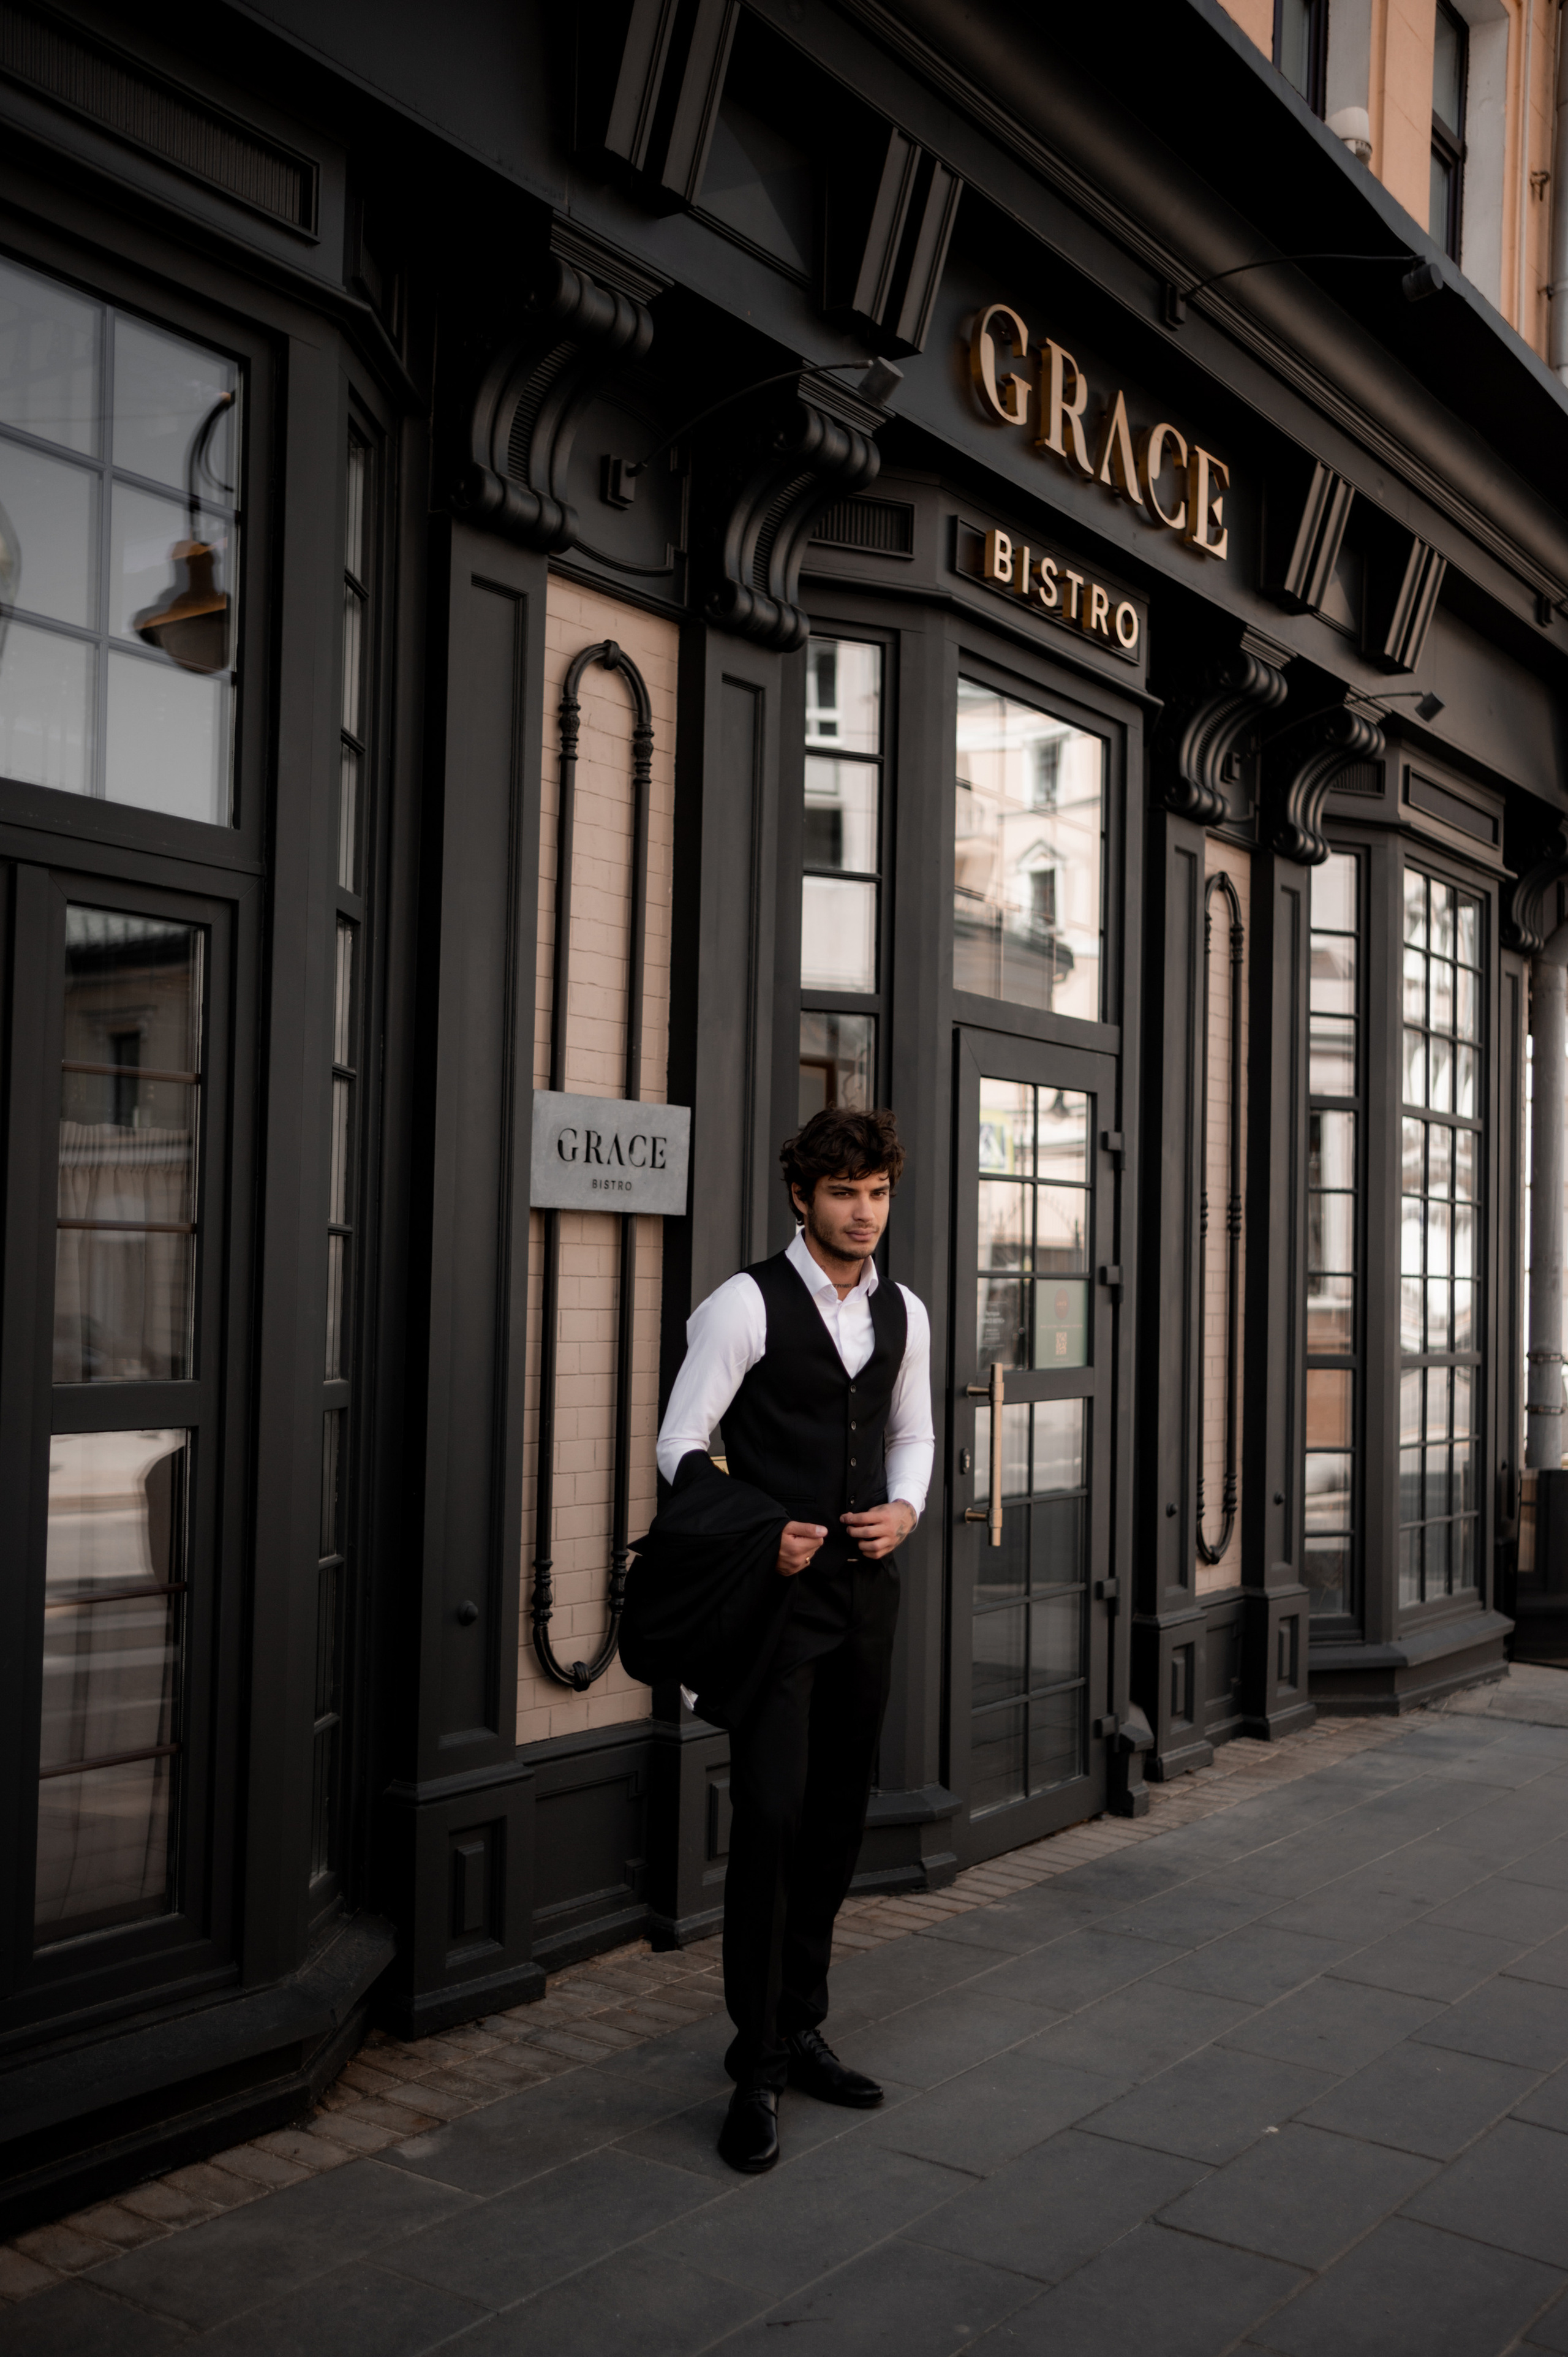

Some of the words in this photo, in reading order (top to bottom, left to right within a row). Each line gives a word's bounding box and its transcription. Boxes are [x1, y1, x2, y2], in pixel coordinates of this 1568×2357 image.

[971, 303, 1231, 561] GRACE
[985, 529, 1139, 649] BISTRO
[557, 1128, 667, 1169] GRACE
[592, 1179, 633, 1191] BISTRO
